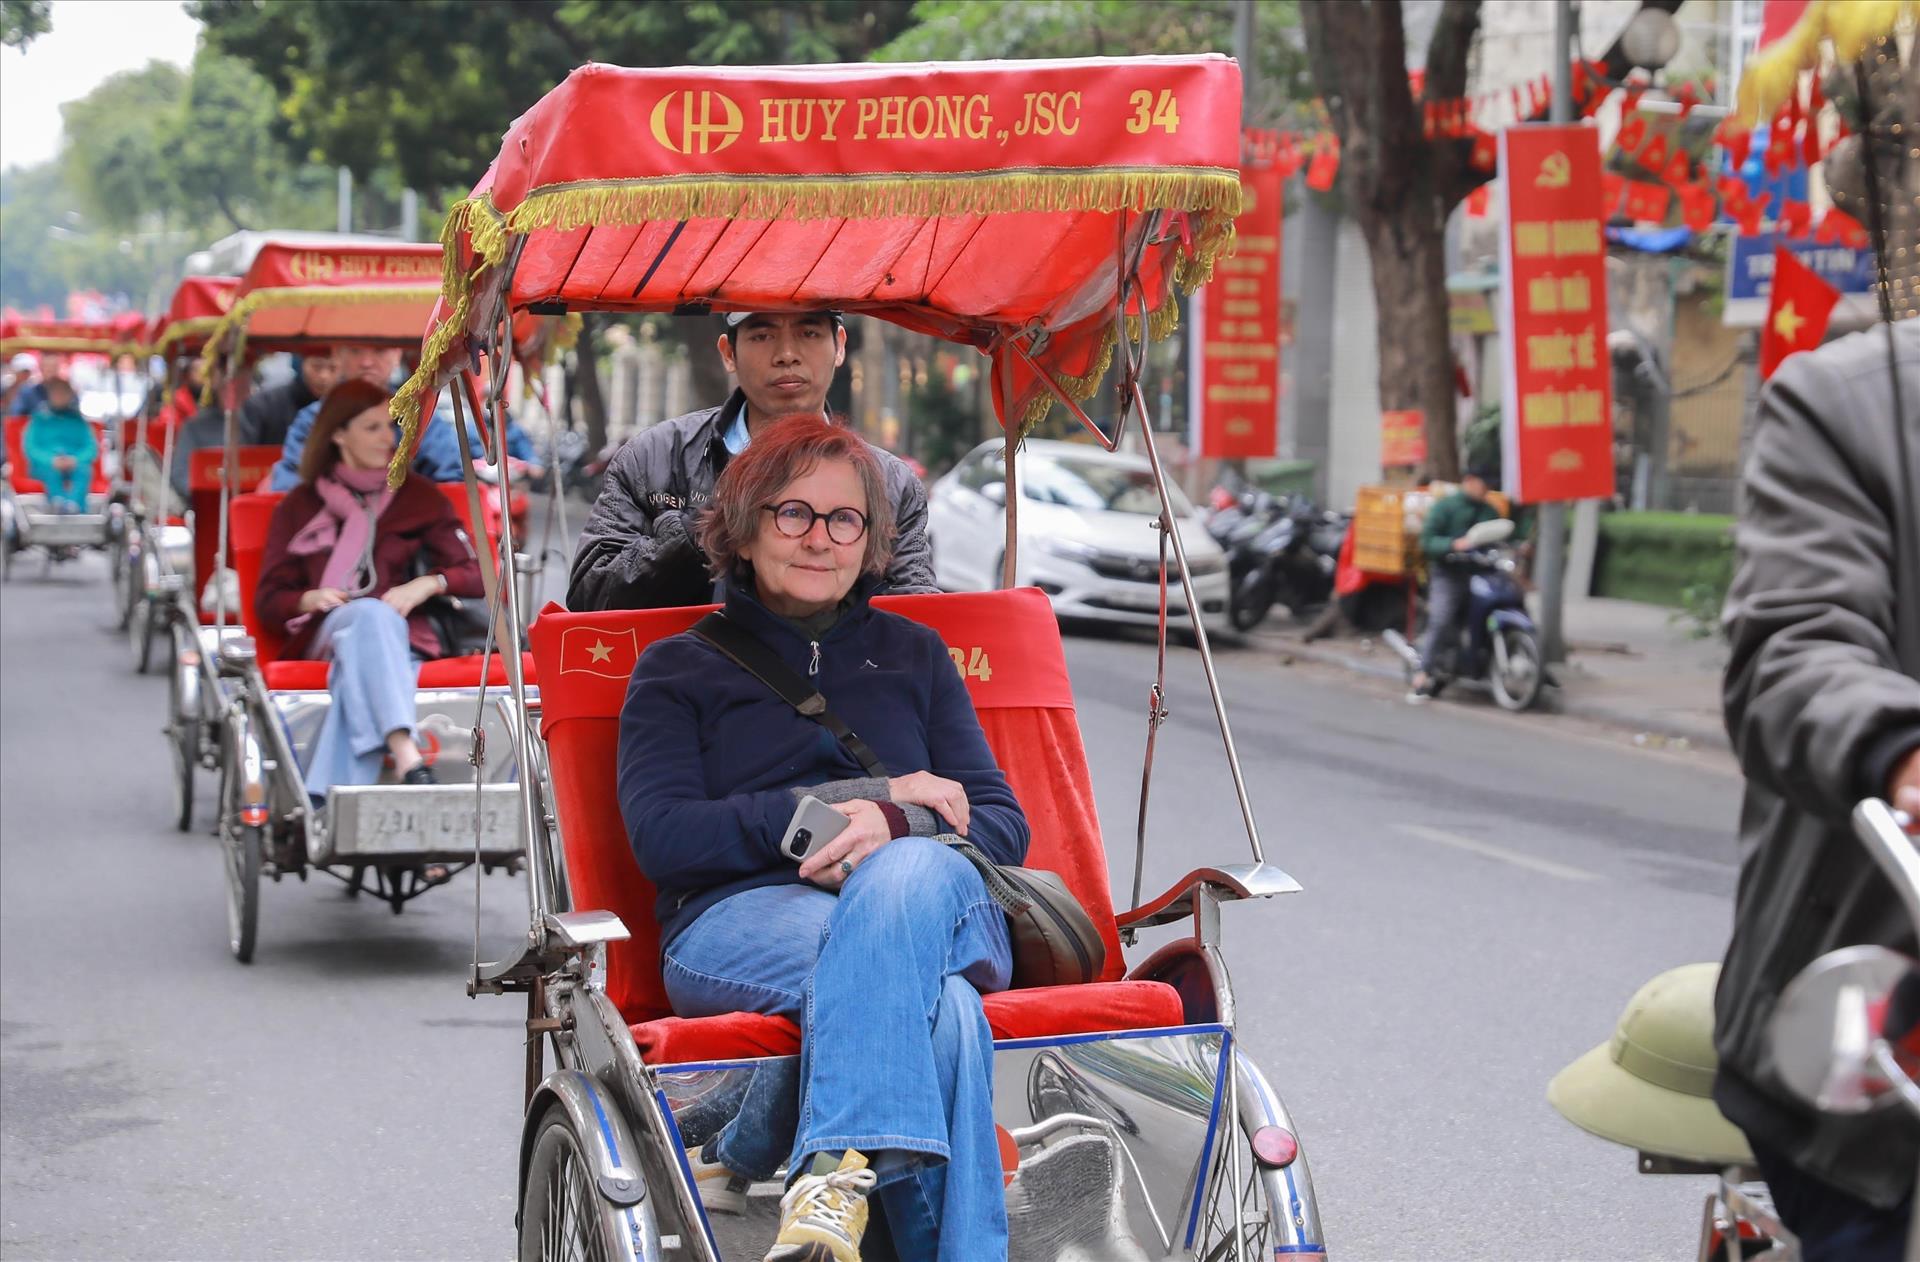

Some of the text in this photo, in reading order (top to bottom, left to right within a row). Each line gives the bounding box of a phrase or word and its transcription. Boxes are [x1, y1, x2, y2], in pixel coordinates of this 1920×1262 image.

[759, 98, 847, 143] HUY
[1014, 91, 1081, 136] JSC
[1126, 89, 1180, 134] 34
[385, 256, 443, 277] PHON
